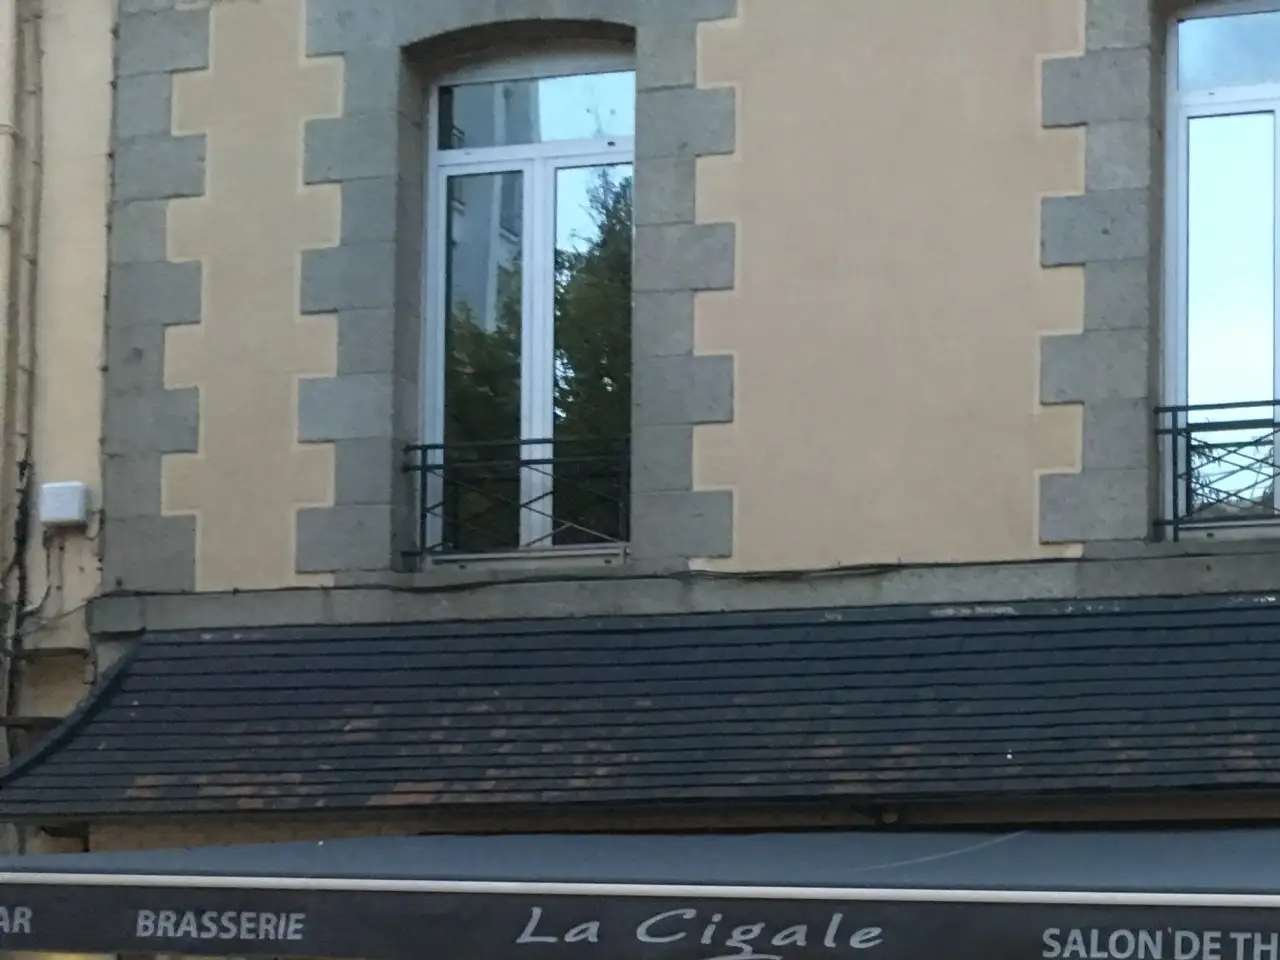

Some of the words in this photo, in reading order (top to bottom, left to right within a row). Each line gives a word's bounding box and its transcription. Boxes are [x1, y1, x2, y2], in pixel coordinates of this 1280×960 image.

[136, 909, 306, 940] BRASSERIE
[516, 905, 601, 944] La
[1042, 927, 1163, 960] SALON
[1173, 930, 1222, 960] DE
